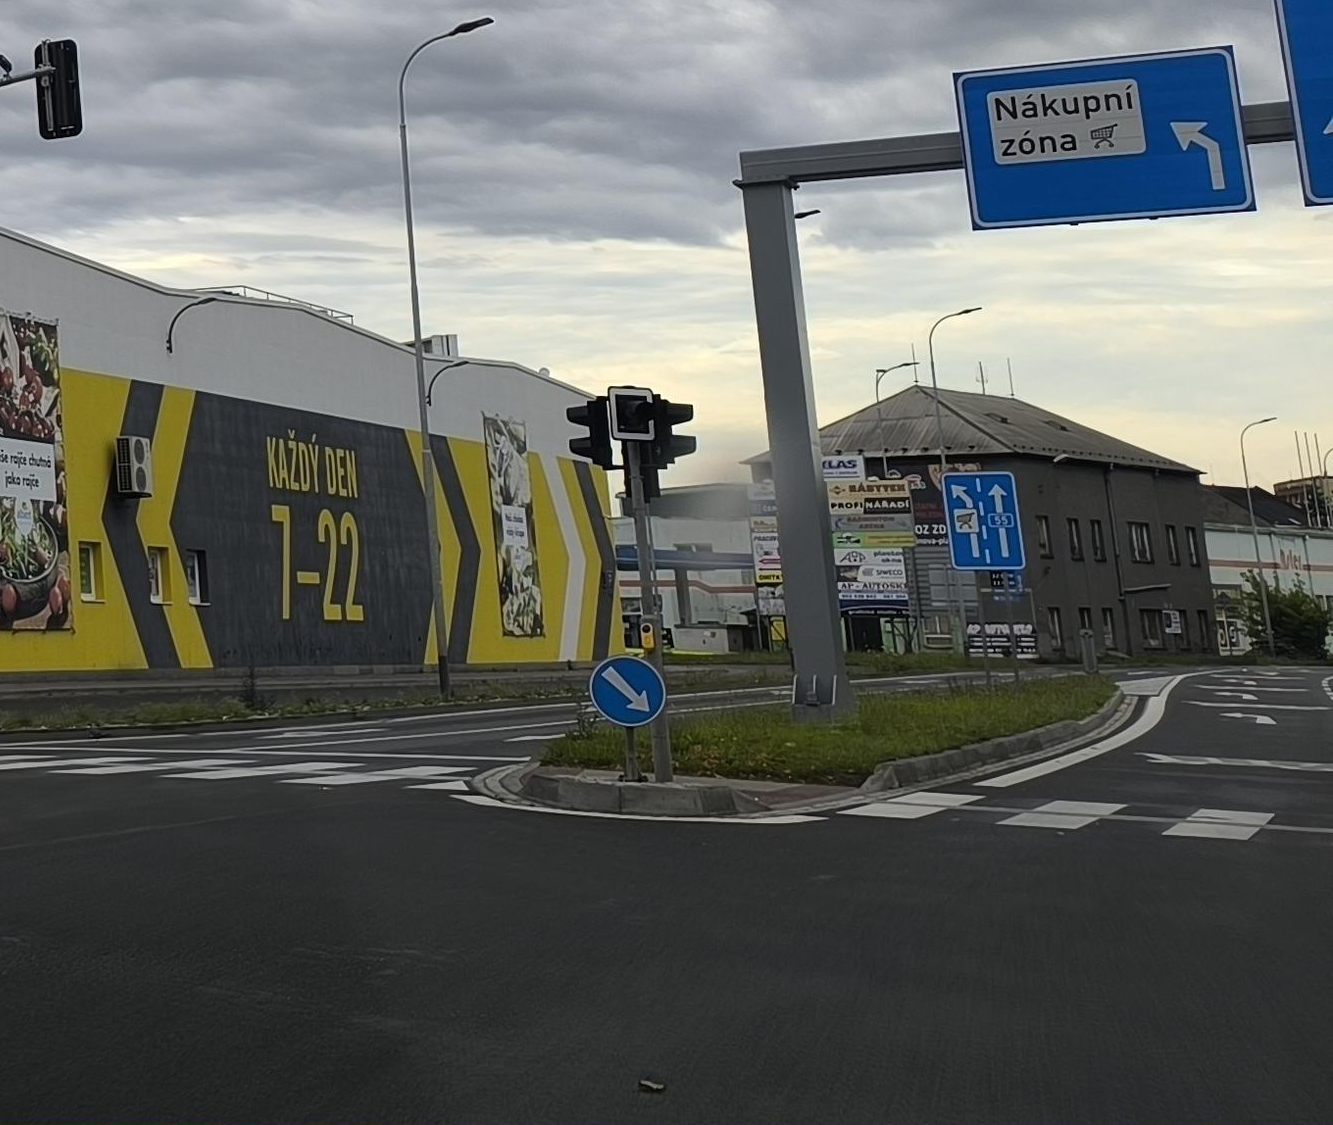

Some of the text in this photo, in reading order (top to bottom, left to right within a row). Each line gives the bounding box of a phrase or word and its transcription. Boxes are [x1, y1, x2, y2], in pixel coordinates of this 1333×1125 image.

[994, 84, 1133, 121] Nákupní
[1000, 130, 1077, 157] zóna
[10, 452, 27, 468] rajče
[266, 429, 358, 498] KAŽDÝ DEN
[5, 472, 21, 487] jako
[865, 500, 909, 509] NÁŘADÍ
[994, 517, 1008, 525] 55
